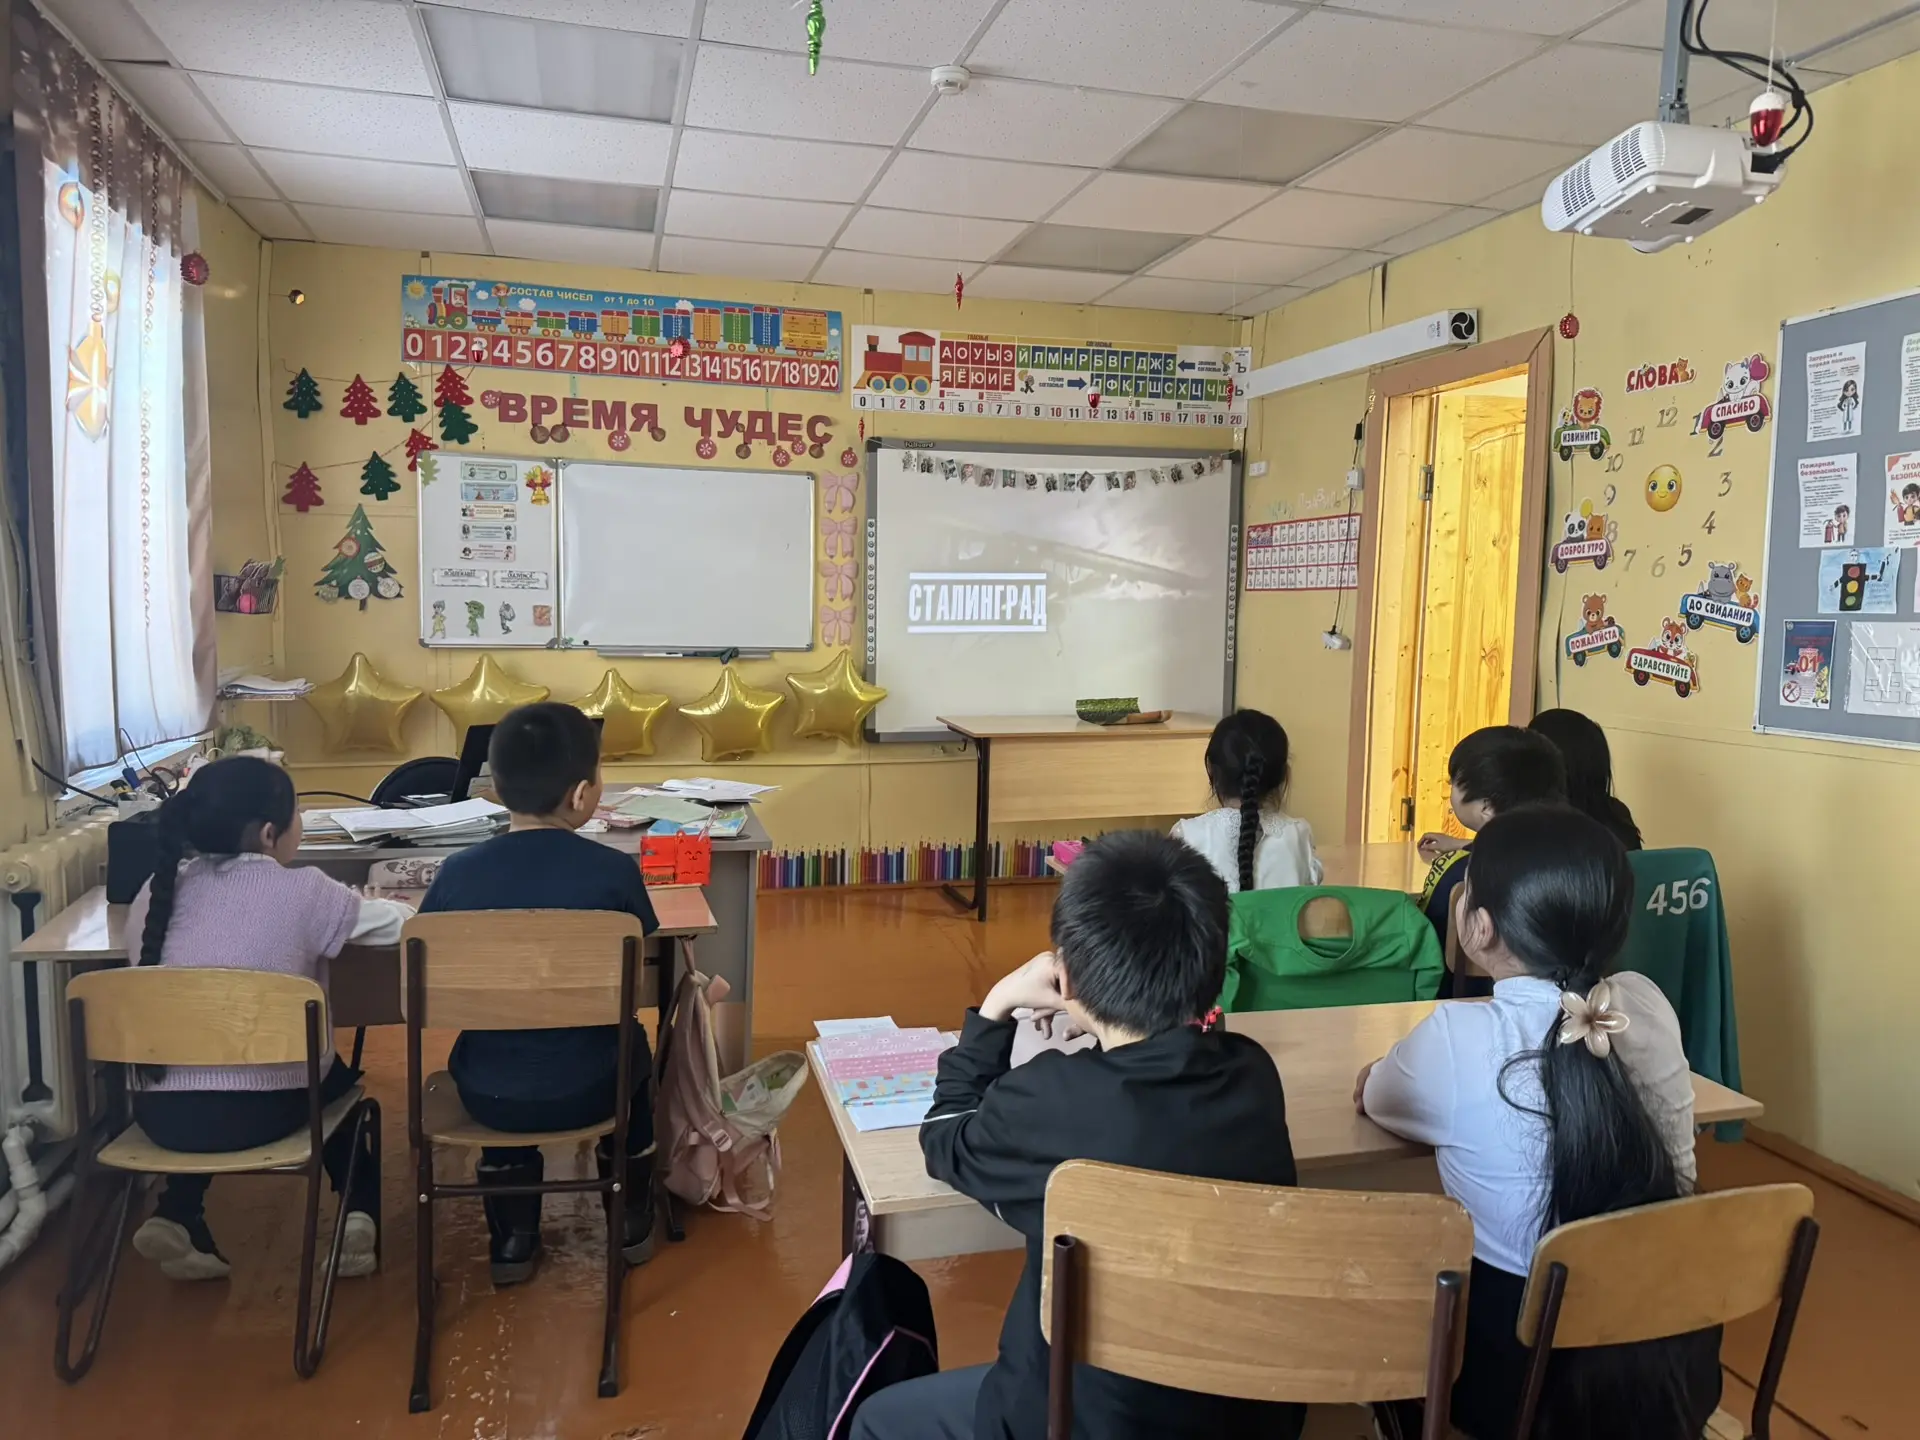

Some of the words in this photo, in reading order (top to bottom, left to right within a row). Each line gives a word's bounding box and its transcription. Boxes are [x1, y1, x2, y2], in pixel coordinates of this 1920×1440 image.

[509, 286, 554, 298] СОСТАВ
[556, 291, 594, 302] ЧИСЕЛ
[604, 296, 616, 304] от
[618, 296, 624, 304] 1
[626, 298, 640, 306] до
[642, 298, 655, 306] 10
[406, 333, 423, 357] 0
[432, 335, 442, 358] 1
[450, 336, 467, 360] 2
[493, 339, 511, 362] 4
[516, 341, 532, 364] 5
[536, 343, 553, 366] 6
[558, 344, 574, 368] 7
[579, 346, 596, 369] 8
[600, 348, 618, 370] 9
[621, 350, 640, 373] 10
[642, 352, 660, 374] 11
[662, 352, 682, 376] 12
[684, 354, 701, 377] 13
[702, 356, 722, 379] 14
[722, 358, 742, 380] 15
[742, 359, 762, 382] 16
[762, 360, 781, 383] 17
[782, 362, 800, 384] 18
[802, 363, 820, 386] 19
[820, 364, 839, 387] 20
[942, 346, 952, 358] А
[956, 348, 968, 360] О
[973, 348, 982, 360] У
[986, 348, 1000, 362] Ы
[1003, 350, 1013, 362] Э
[1019, 348, 1028, 363] Й
[1033, 352, 1044, 364] Л
[1048, 352, 1059, 365] М
[1064, 353, 1074, 366] Н
[1079, 354, 1088, 366] Р
[1094, 354, 1103, 367] Б
[1108, 356, 1118, 368] В
[1123, 356, 1132, 368] Г
[1136, 356, 1148, 370] Д
[1150, 358, 1162, 370] Ж
[1235, 362, 1247, 374] Ъ
[942, 370, 952, 383] Я
[957, 368, 967, 384] Ё
[970, 372, 985, 384] Ю
[988, 372, 998, 385] И
[1003, 374, 1012, 386] Е
[1626, 363, 1680, 392] СЛОВА
[1106, 379, 1118, 390] Ф
[1122, 380, 1132, 392] К
[1136, 380, 1146, 392] Т
[1148, 381, 1162, 393] Ш
[1164, 382, 1173, 394] С
[1178, 383, 1187, 394] Х
[1192, 384, 1202, 398] Ц
[1207, 384, 1216, 396] Ч
[1234, 385, 1244, 396] Ь
[498, 391, 660, 433] ВРЕМЯ
[683, 405, 834, 447] ЧУДЕС
[859, 396, 866, 407] 0
[880, 398, 886, 408] 1
[900, 398, 906, 409] 2
[919, 400, 926, 410] 3
[938, 400, 945, 412] 4
[958, 402, 964, 412] 5
[977, 403, 984, 414] 6
[996, 404, 1003, 414] 7
[1016, 405, 1022, 416] 8
[1034, 406, 1040, 416] 9
[1050, 407, 1062, 418] 10
[1069, 408, 1080, 418] 11
[1088, 408, 1100, 418] 12
[1106, 410, 1118, 420] 13
[1124, 410, 1135, 420] 14
[1142, 412, 1154, 422] 15
[1160, 412, 1172, 422] 16
[1178, 412, 1189, 423] 17
[1195, 414, 1206, 424] 18
[1213, 414, 1224, 424] 19
[1230, 415, 1242, 425] 20
[1656, 407, 1678, 428] 12
[1715, 398, 1756, 418] СПАСИБО
[1690, 412, 1702, 436] 1
[1562, 430, 1598, 442] ИЗВИНИТЕ
[1628, 426, 1646, 447] 11
[1708, 436, 1724, 458] 2
[1604, 453, 1624, 473] 10
[1603, 484, 1616, 506] 9
[1718, 472, 1732, 497] 3
[1606, 520, 1618, 542] 8
[1702, 511, 1716, 534] 4
[1559, 544, 1586, 558] ДОБРОЕ
[1587, 541, 1604, 554] УТРО
[1678, 544, 1692, 566] 5
[1623, 550, 1636, 572] 7
[1651, 556, 1666, 578] 6
[908, 582, 1048, 626] СТАЛИНГРАД
[1689, 598, 1702, 611] ДО
[1704, 601, 1752, 624] СВИДАНИЯ
[1570, 628, 1618, 650] ПОЖАЛУЙСТА
[1632, 654, 1689, 680] ЗДРАВСТВУЙТЕ
[1800, 655, 1817, 673] 01
[1646, 877, 1712, 916] 456
